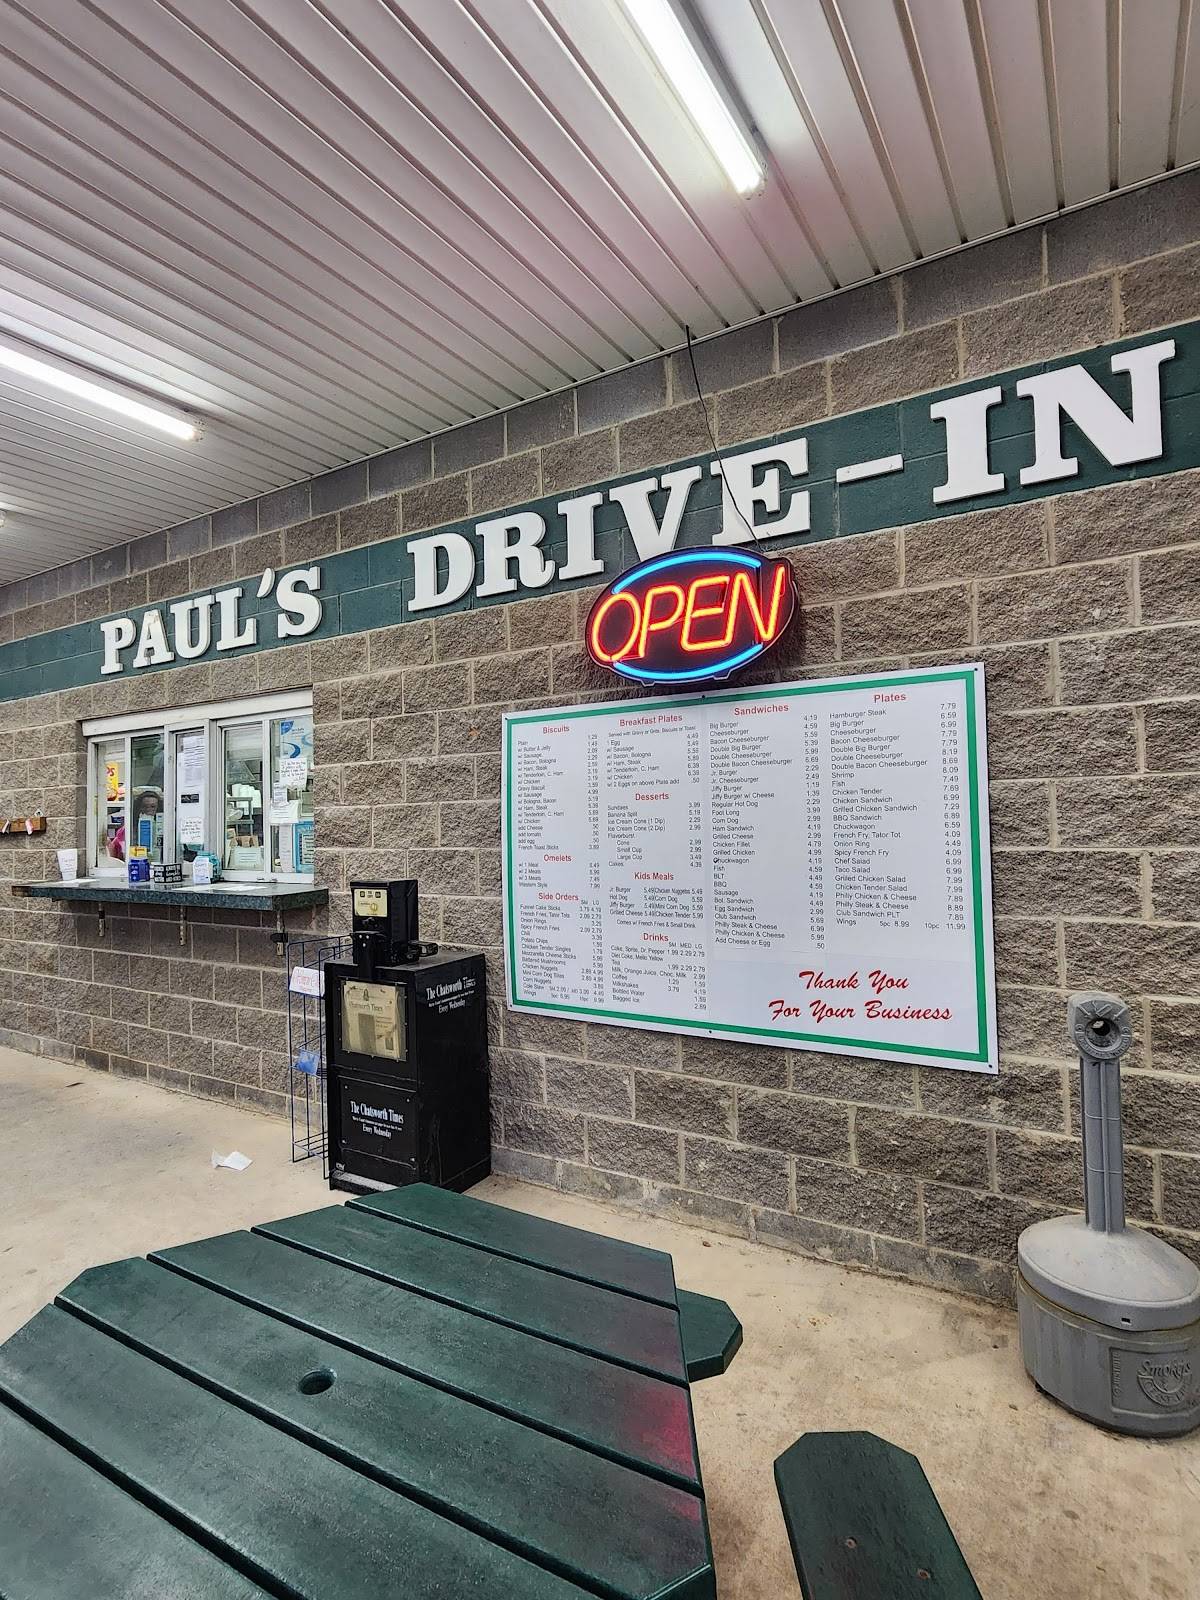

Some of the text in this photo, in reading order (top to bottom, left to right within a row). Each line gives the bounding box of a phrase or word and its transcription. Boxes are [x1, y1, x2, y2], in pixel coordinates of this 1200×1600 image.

[592, 565, 786, 662] OPEN
[100, 566, 322, 674] PAUL'S
[874, 693, 906, 703] Plates
[734, 704, 788, 715] Sandwiches
[829, 711, 866, 719] Hamburger
[867, 708, 886, 716] Steak
[619, 714, 682, 726] Breakfast Plates
[829, 720, 840, 728] Big
[842, 717, 864, 727] Burger
[542, 725, 569, 734] Biscuits
[830, 726, 876, 736] Cheeseburger
[852, 734, 899, 743] Cheeseburger
[830, 745, 853, 753] Double
[855, 744, 866, 752] Big
[855, 752, 903, 760] Cheeseburger
[878, 759, 927, 767] Cheeseburger
[831, 770, 854, 780] Shrimp
[831, 780, 845, 788] Fish
[635, 792, 669, 800] Desserts
[859, 795, 892, 803] Sandwich
[833, 822, 875, 831] Chuckwagon
[854, 840, 870, 848] Ring
[543, 853, 571, 861] Omelets
[834, 848, 851, 857] Spicy
[853, 848, 876, 856] French
[878, 848, 889, 857] Fry
[851, 865, 870, 873] Salad
[634, 871, 674, 880] Kids Meals
[862, 883, 886, 891] Tender
[538, 892, 579, 901] Side Orders
[835, 891, 853, 900] Philly
[854, 892, 881, 900] Chicken
[890, 893, 916, 901] Cheese
[835, 900, 853, 909] Philly
[854, 900, 874, 908] Steak
[882, 901, 908, 909] Cheese
[835, 908, 851, 916] Club
[852, 909, 885, 917] Sandwich
[835, 917, 856, 926] Wings
[643, 932, 669, 942] Drinks
[799, 969, 909, 994] Thank You
[426, 988, 436, 1000] The
[436, 979, 463, 997] Chatsworth
[768, 999, 952, 1023] For Your Business
[350, 1100, 360, 1114] The
[360, 1102, 388, 1121] Chatsworth
[388, 1109, 404, 1124] Times
